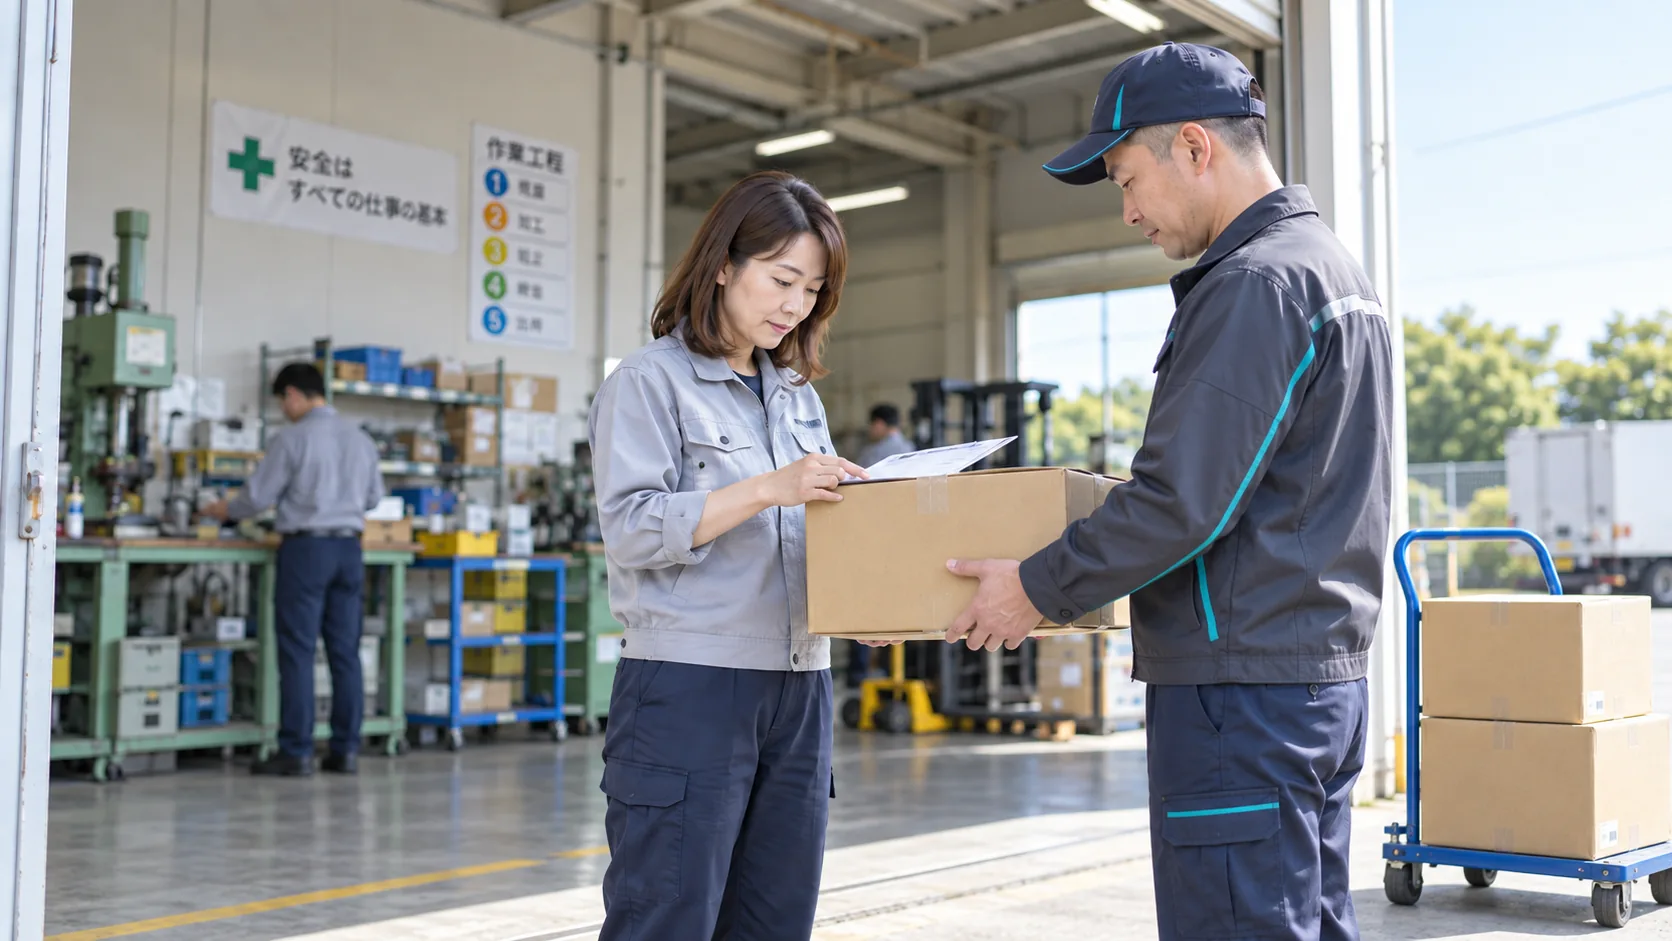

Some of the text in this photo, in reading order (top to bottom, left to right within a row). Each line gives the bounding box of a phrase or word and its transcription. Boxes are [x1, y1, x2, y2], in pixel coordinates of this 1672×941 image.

[288, 145, 354, 179] 安全は
[486, 136, 564, 175] 作業工程
[288, 178, 448, 227] すべての仕事の基本
[489, 205, 502, 227] 2
[488, 240, 502, 262] 3
[488, 275, 501, 297] 4
[488, 310, 501, 331] 5
